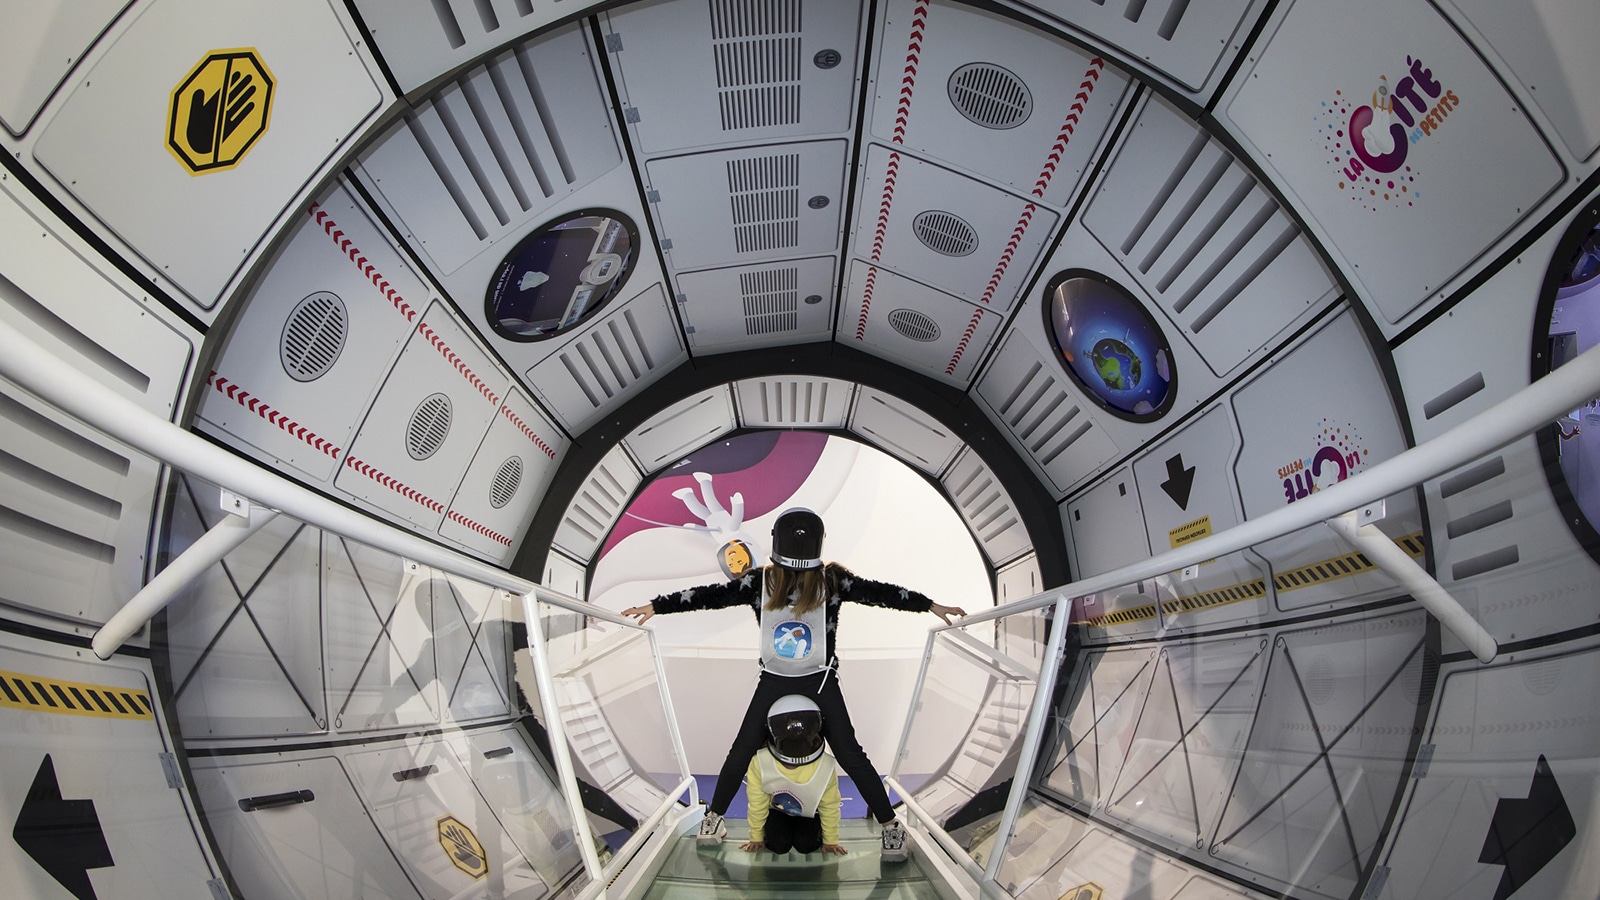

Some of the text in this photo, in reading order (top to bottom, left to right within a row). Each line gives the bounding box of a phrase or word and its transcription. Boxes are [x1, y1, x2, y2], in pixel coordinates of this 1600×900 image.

[1343, 54, 1442, 182] LA CITÉ
[1409, 89, 1460, 144] DES PETITS
[1278, 458, 1303, 479] PETITS
[1345, 451, 1360, 469] LA
